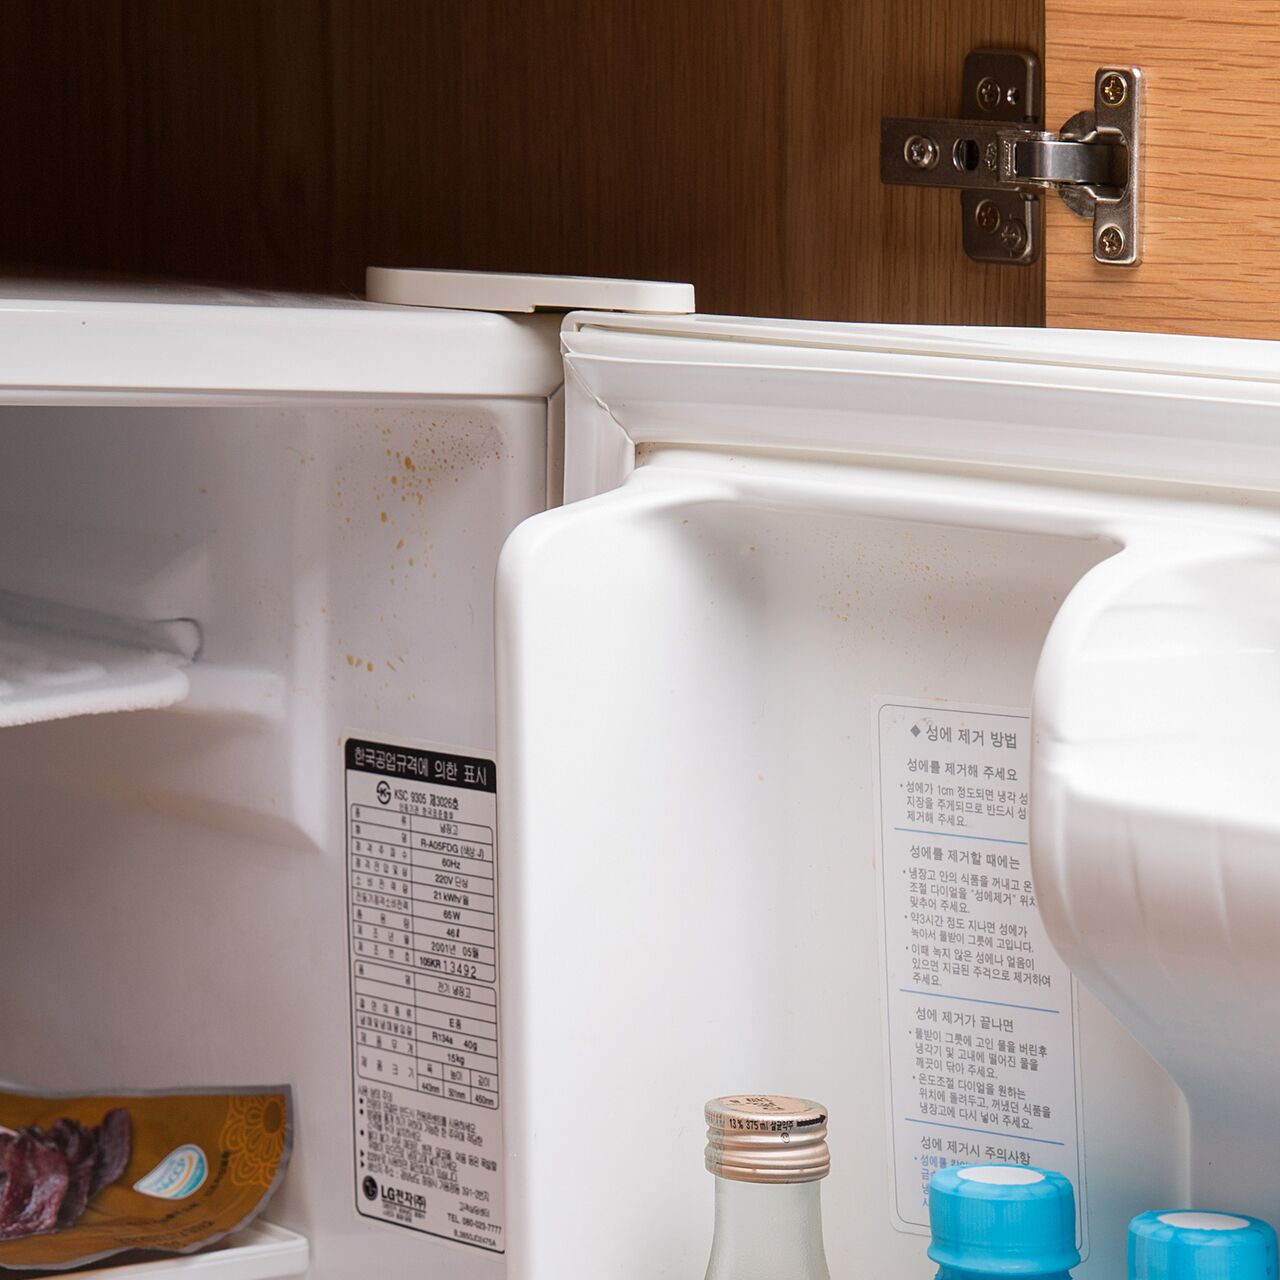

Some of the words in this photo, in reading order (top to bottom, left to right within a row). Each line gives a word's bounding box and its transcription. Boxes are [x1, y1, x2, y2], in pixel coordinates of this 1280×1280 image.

[926, 724, 951, 743] 성에
[957, 727, 984, 746] 제거
[990, 731, 1016, 749] 방법
[354, 746, 429, 776] 한국공업규격에
[434, 758, 457, 781] 의한
[463, 763, 486, 786] 표시
[906, 757, 940, 774] 성에를
[944, 761, 977, 778] 제거해
[983, 765, 1017, 783] 주세요
[905, 779, 932, 795] 성에가
[937, 783, 953, 797] 1cm
[956, 785, 993, 802] 정도되면
[997, 789, 1016, 804] 냉각
[909, 844, 943, 861] 성에를
[947, 849, 980, 866] 제거할
[986, 853, 1020, 871] 때에는
[910, 910, 943, 928] 약3시간
[946, 915, 965, 931] 정도
[968, 918, 995, 935] 지나면
[999, 922, 1028, 939] 성에가
[912, 956, 938, 972] 있으면
[942, 960, 969, 976] 지급된
[973, 965, 1010, 982] 주걱으로
[1013, 970, 1051, 988] 제거하여
[916, 1006, 937, 1023] 성에
[942, 1010, 975, 1028] 제거가
[980, 1015, 1013, 1034] 끝나면
[920, 1135, 942, 1151] 성에
[946, 1140, 980, 1158] 제거시
[984, 1146, 1030, 1166] 주의사항
